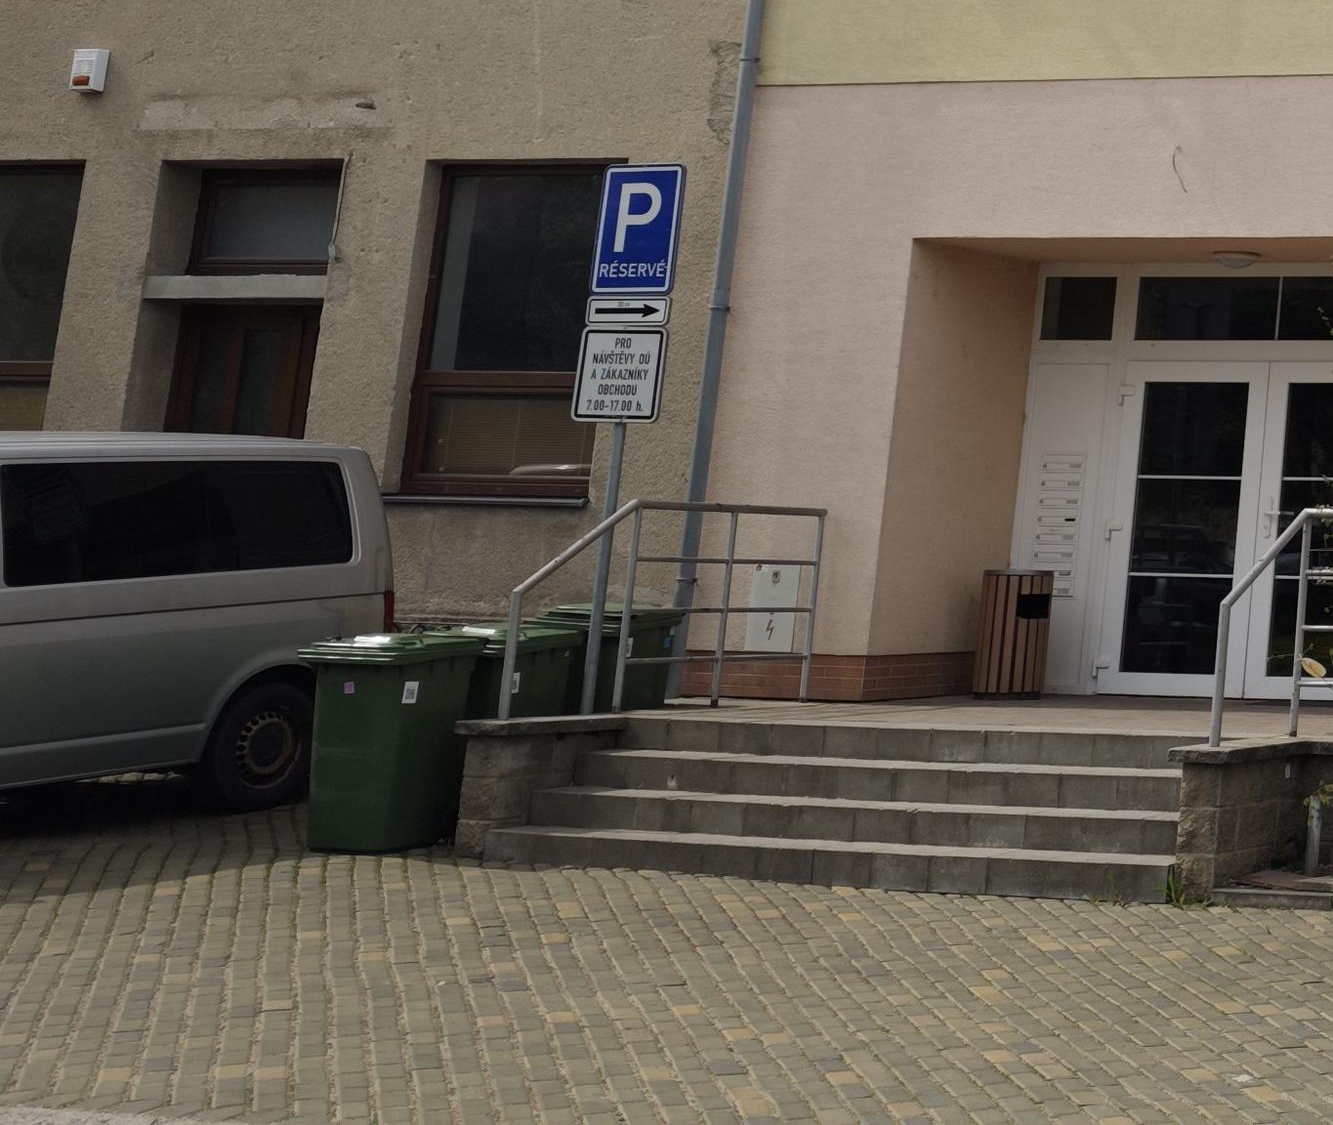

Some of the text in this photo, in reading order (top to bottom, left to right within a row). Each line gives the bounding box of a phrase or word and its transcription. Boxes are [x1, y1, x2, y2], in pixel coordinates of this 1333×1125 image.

[613, 182, 662, 253] P
[599, 259, 666, 278] RÉSERVÉ
[614, 337, 632, 349] PRO
[592, 350, 651, 365] NÁVŠTĚVY OÚ
[590, 366, 649, 380] A ZÁKAZNÍKY
[598, 384, 638, 395] OBCHODU
[586, 399, 632, 411] 7.00-17.00
